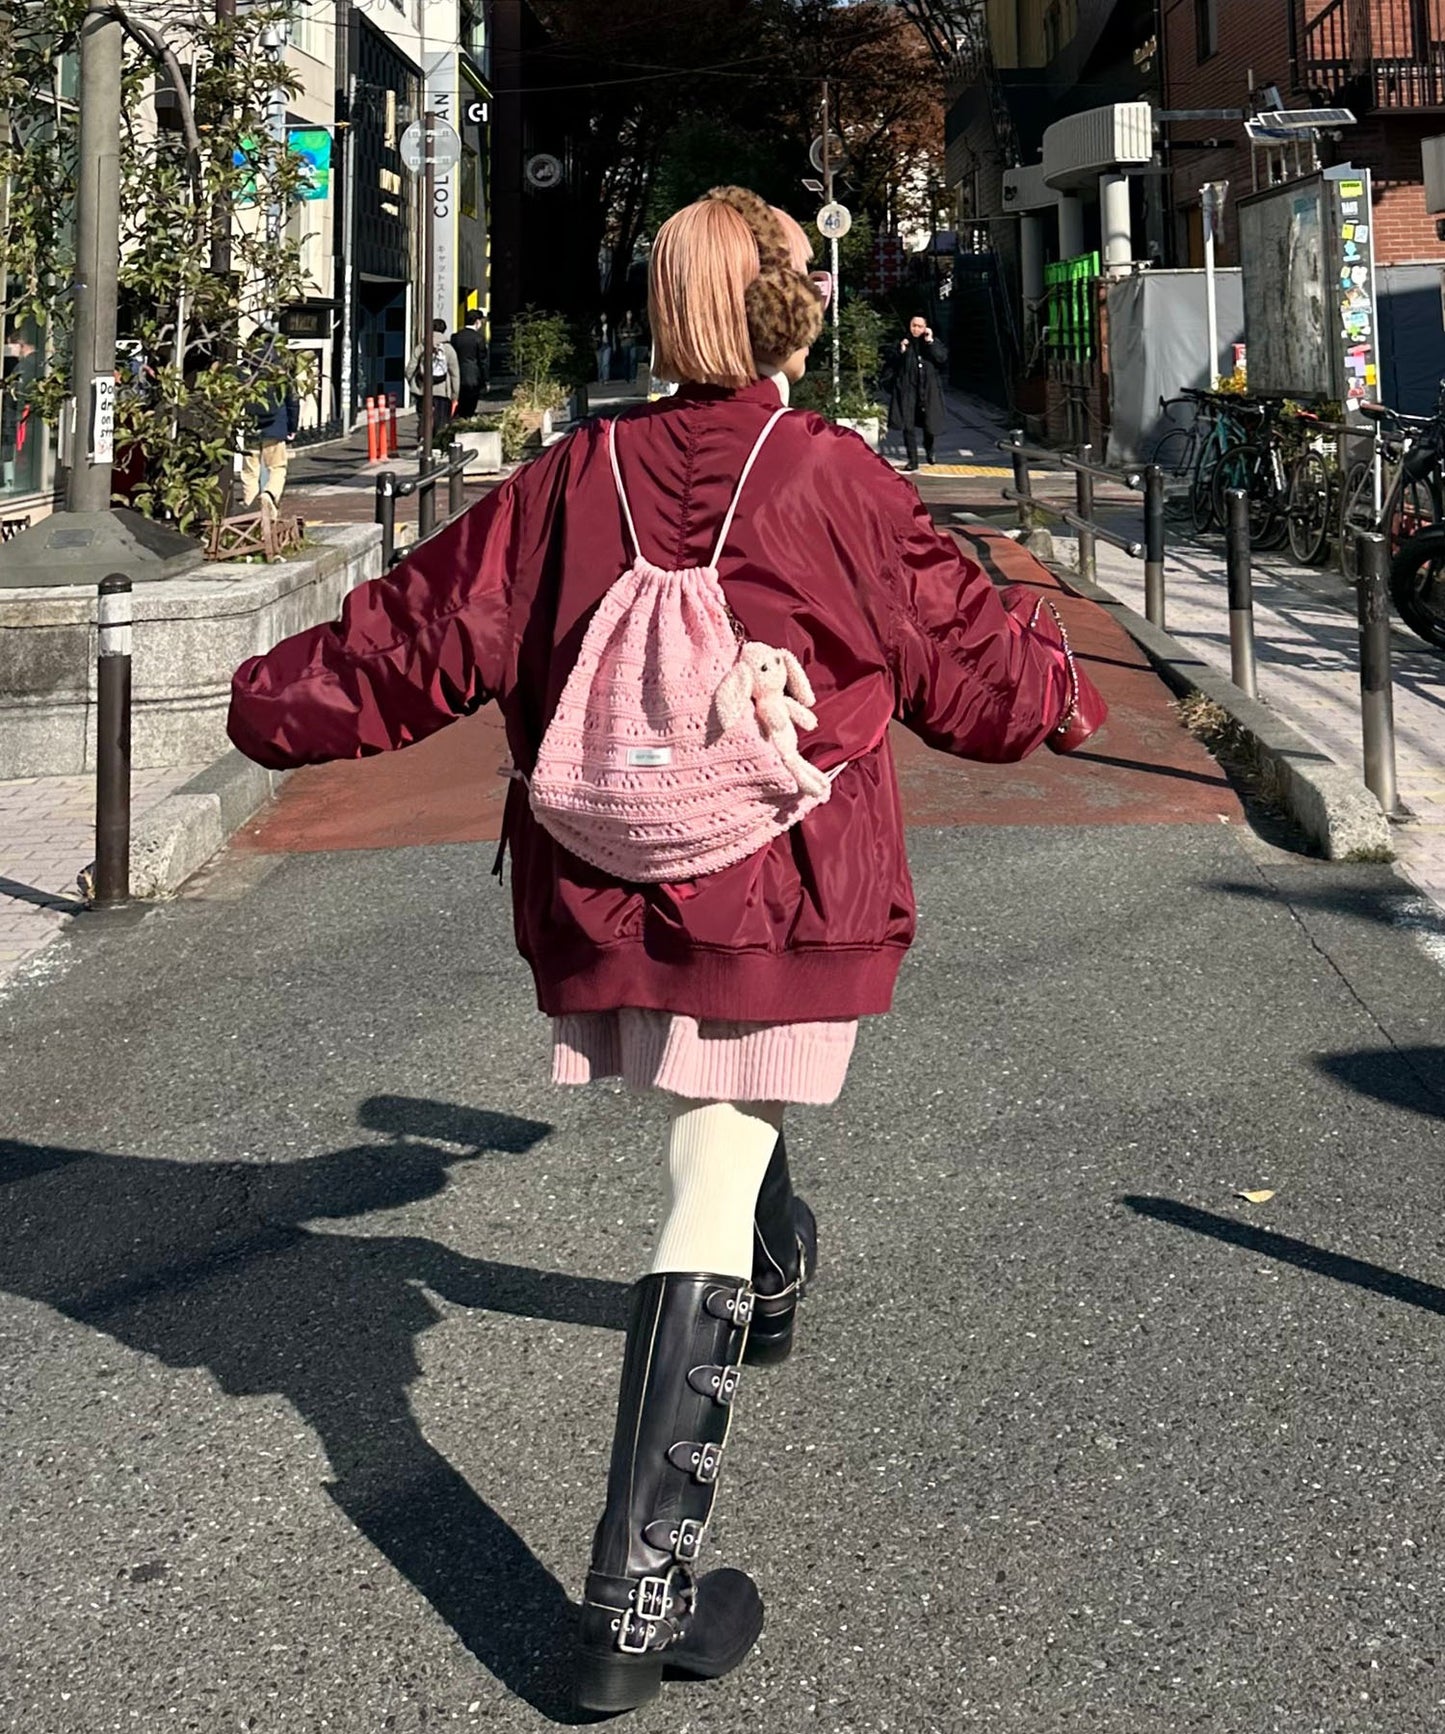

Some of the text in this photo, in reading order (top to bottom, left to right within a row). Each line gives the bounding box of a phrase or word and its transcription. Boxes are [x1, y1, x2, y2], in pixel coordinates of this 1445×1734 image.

[434, 176, 449, 218] COL
[100, 382, 113, 394] Do
[101, 399, 112, 410] dr
[100, 429, 113, 437] str
